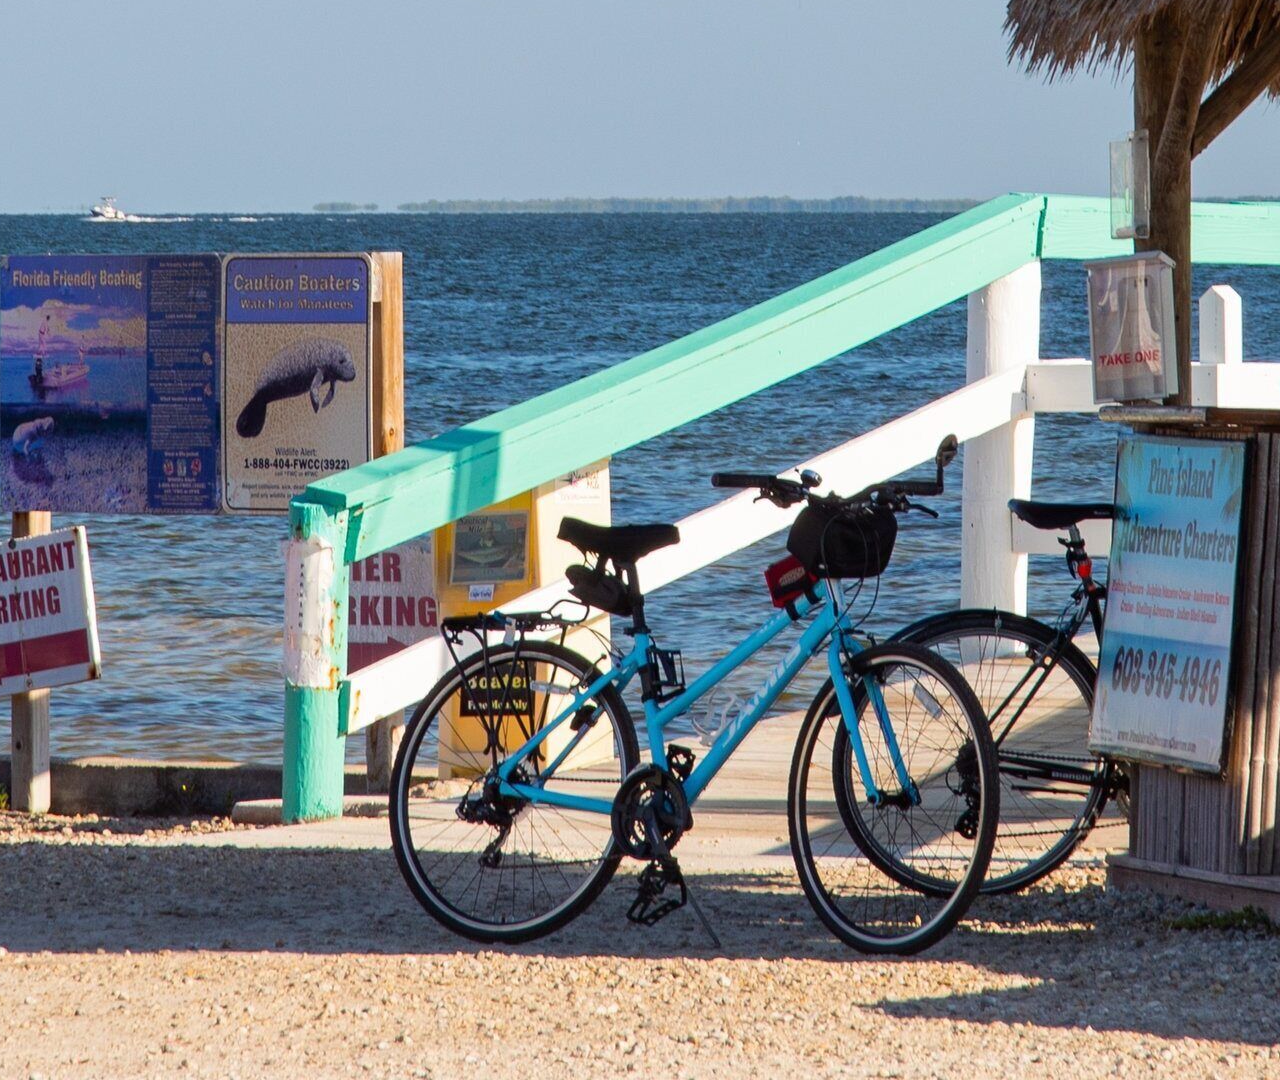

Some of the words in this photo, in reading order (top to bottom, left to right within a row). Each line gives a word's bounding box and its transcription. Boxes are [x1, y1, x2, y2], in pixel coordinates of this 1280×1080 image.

[12, 270, 50, 287] Florida
[53, 270, 97, 290] Friendly
[100, 270, 142, 290] Boating
[234, 274, 294, 291] Caution
[299, 274, 360, 291] Boaters
[240, 299, 275, 309] Watch
[278, 299, 293, 309] for
[298, 299, 353, 309] Manatees
[1099, 353, 1131, 367] TAKE
[1135, 349, 1160, 363] ONE
[275, 447, 299, 456] Wildlife
[1148, 458, 1174, 495] Pine
[1175, 458, 1216, 499] Island
[1121, 513, 1183, 557] Adventure
[1184, 519, 1237, 564] Charters
[351, 552, 402, 582] IER
[349, 596, 437, 628] KING
[1111, 645, 1221, 707] 603-345-4946
[1051, 771, 1092, 781] Bianchi
